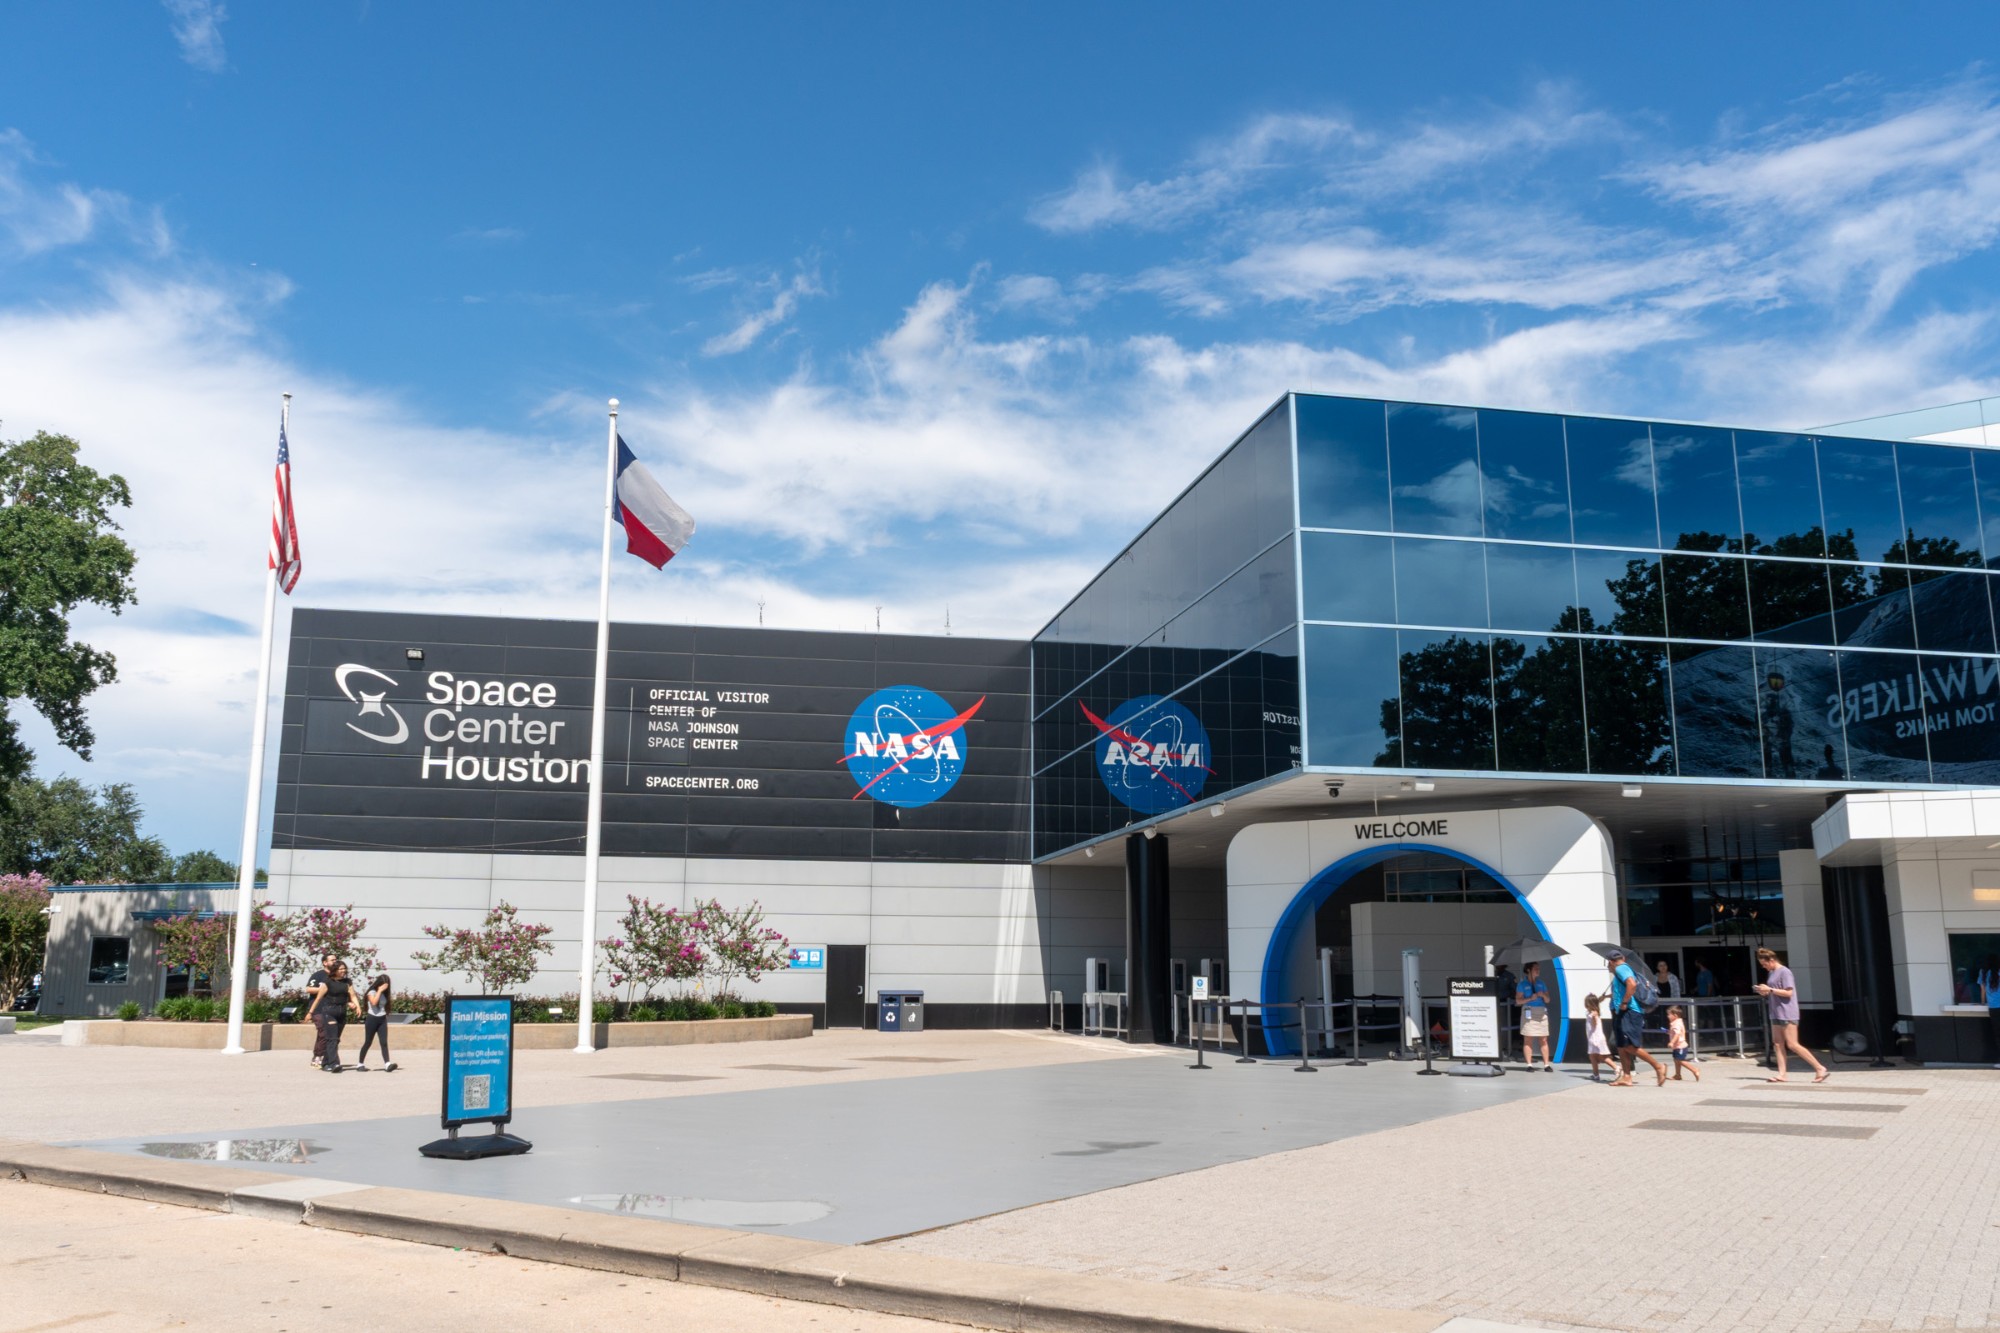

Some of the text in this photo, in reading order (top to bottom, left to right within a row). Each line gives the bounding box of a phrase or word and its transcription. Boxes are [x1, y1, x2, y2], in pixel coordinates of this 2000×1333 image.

[426, 671, 557, 712] Space
[649, 689, 770, 704] OFFICIAL VISITOR
[649, 705, 717, 718] CENTER OF
[424, 708, 565, 745] Center
[648, 721, 739, 735] NASA JOHNSON
[647, 737, 738, 750] SPACE CENTER
[855, 731, 960, 760] NASA
[422, 746, 592, 783] Houston
[646, 776, 759, 790] SPACECENTER.ORG
[1354, 819, 1448, 839] WELCOME
[452, 1011, 507, 1021] Final Mission
